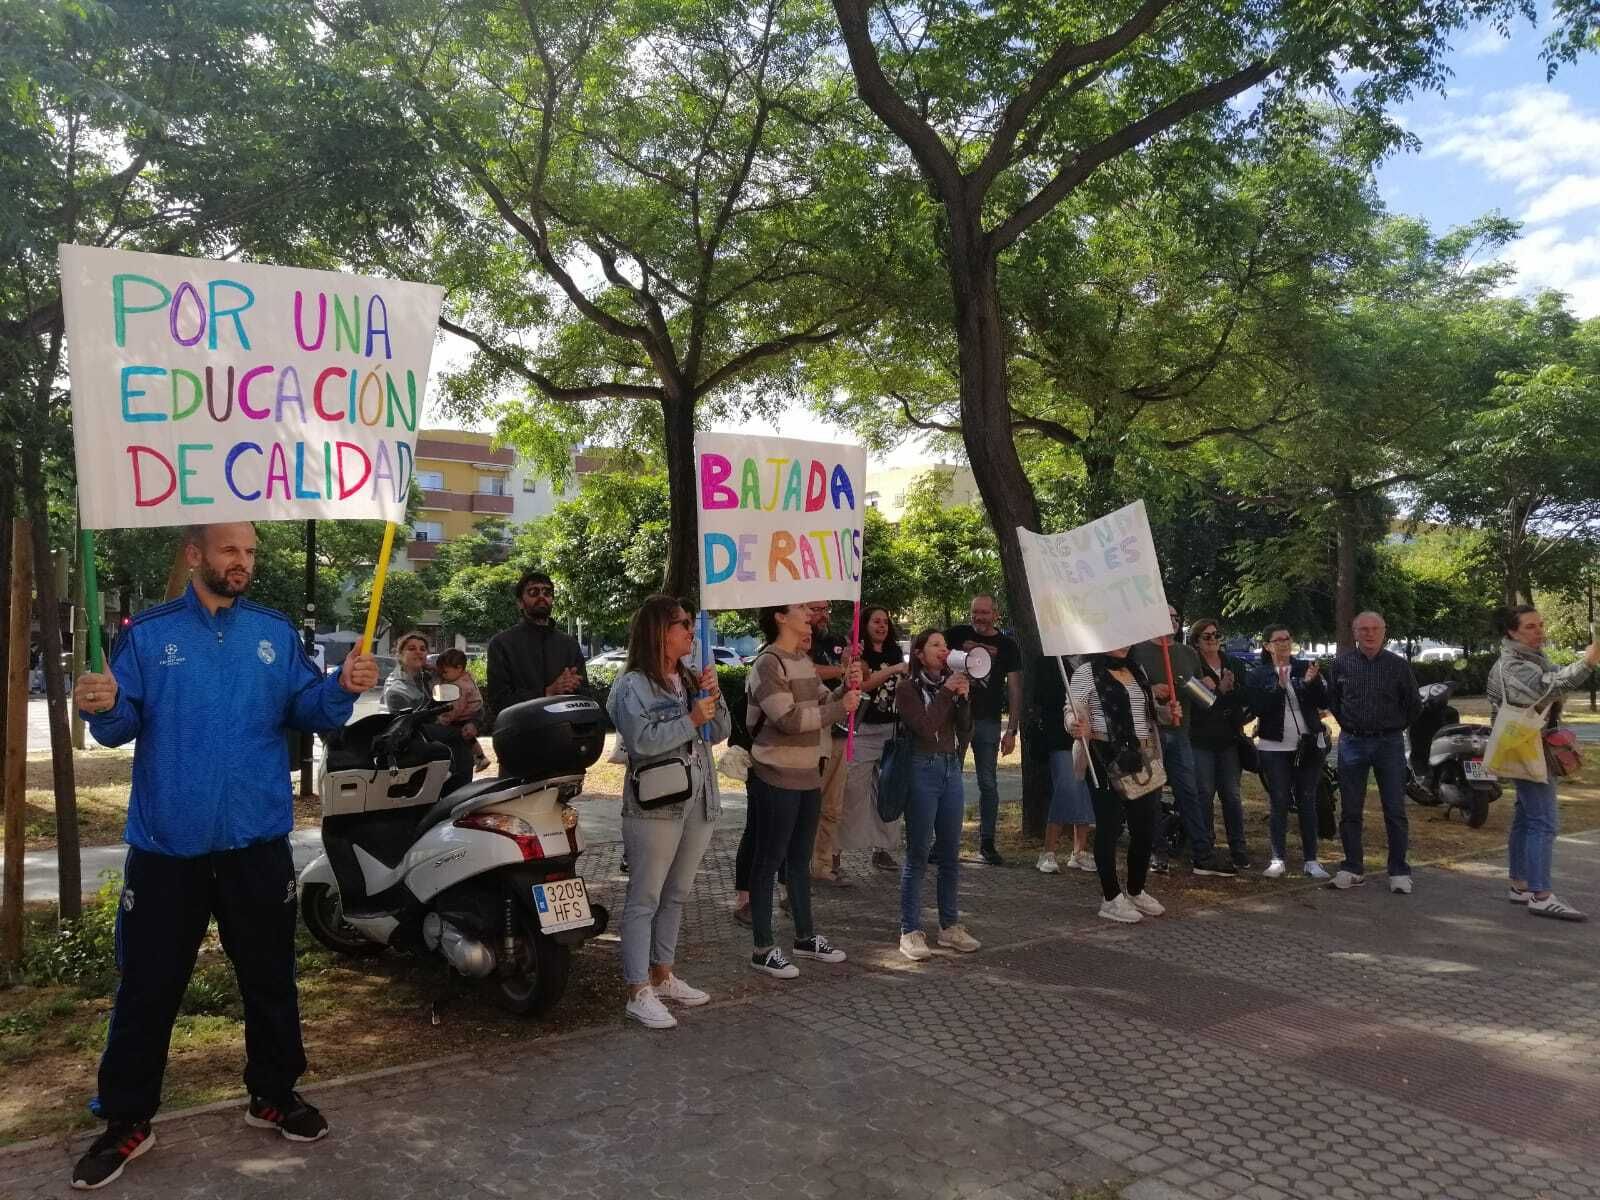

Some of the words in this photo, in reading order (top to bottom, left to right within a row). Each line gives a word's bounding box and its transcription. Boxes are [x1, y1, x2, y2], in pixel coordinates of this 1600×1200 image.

[112, 273, 255, 351] POR
[294, 290, 392, 359] UNA
[121, 363, 416, 432] EDUCACIÓN
[127, 444, 214, 507] DE
[224, 440, 413, 504] CALIDAD
[700, 453, 855, 513] BAJADA
[703, 532, 758, 585] DE
[768, 527, 861, 582] RATIOS
[547, 881, 583, 902] 3209
[554, 900, 582, 921] HFS
